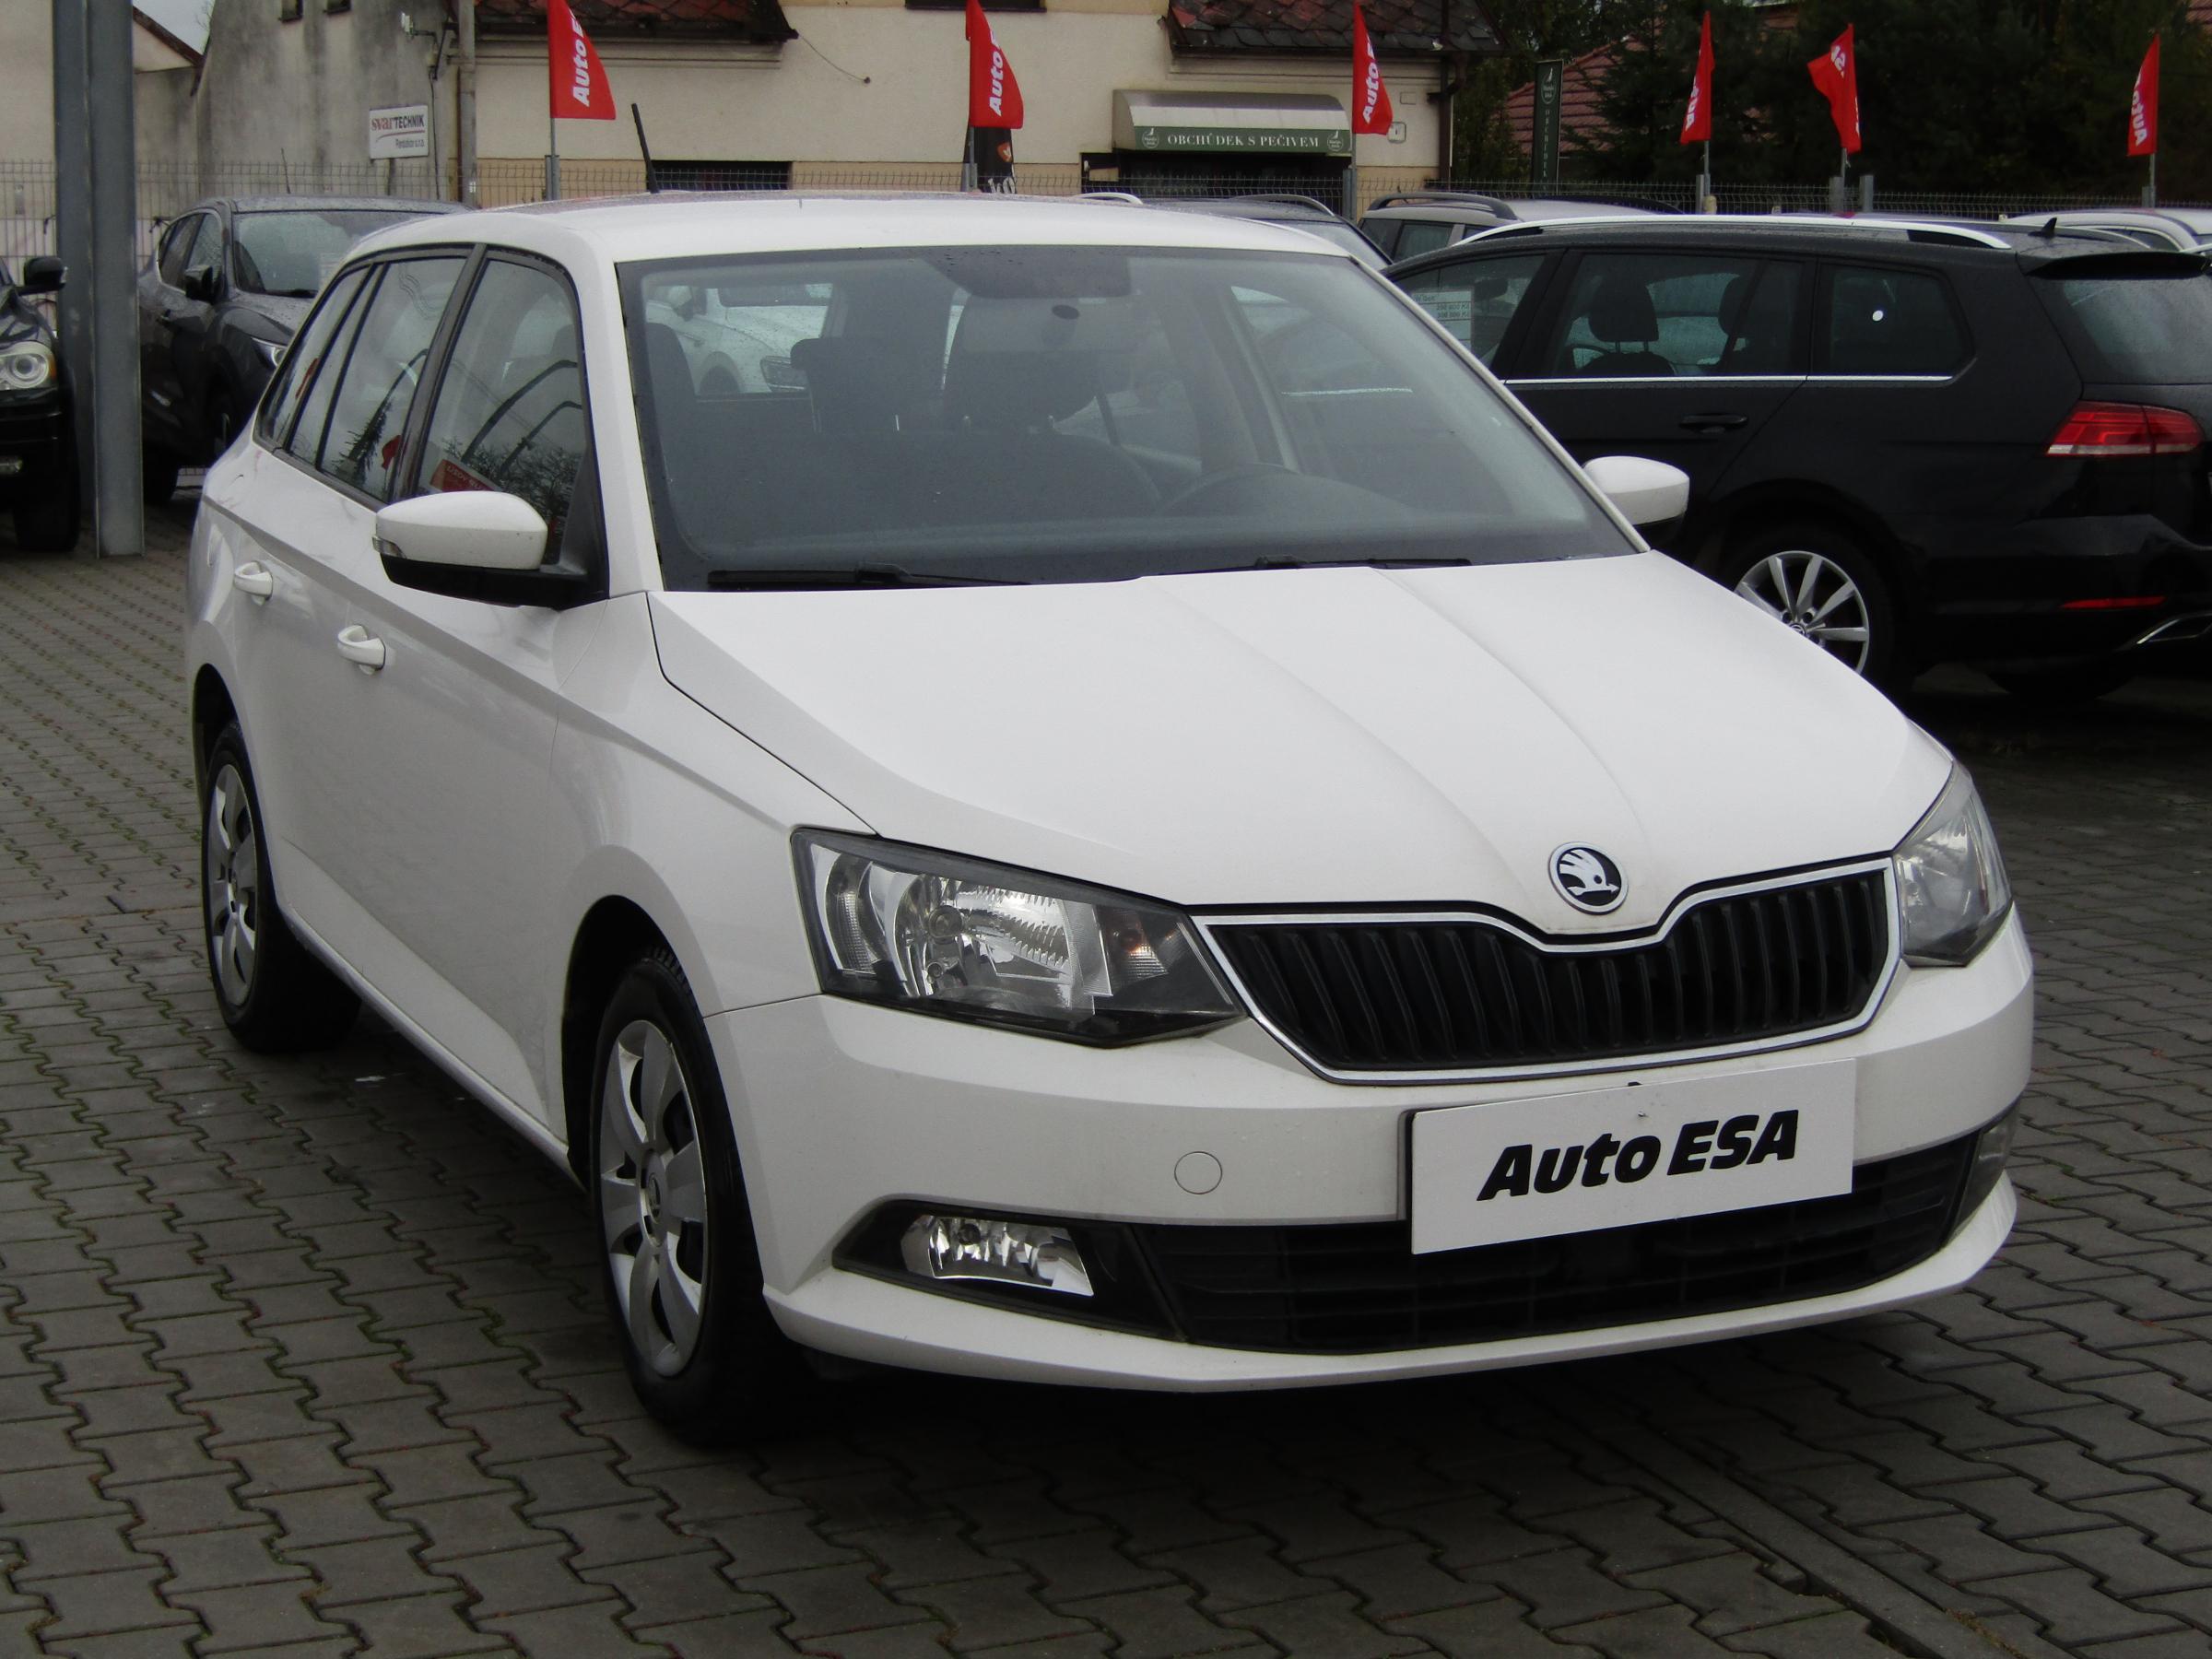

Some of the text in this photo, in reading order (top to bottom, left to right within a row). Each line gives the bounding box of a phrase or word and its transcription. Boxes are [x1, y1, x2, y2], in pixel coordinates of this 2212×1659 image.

[572, 39, 590, 108] Auto
[988, 51, 1004, 117] Auto
[1362, 62, 1379, 124] Auto
[1167, 132, 1244, 147] OBCHŮDEK
[1248, 134, 1256, 147] S
[1260, 134, 1319, 147] PEČIVEM
[1477, 1109, 1799, 1202] Auto ESA
